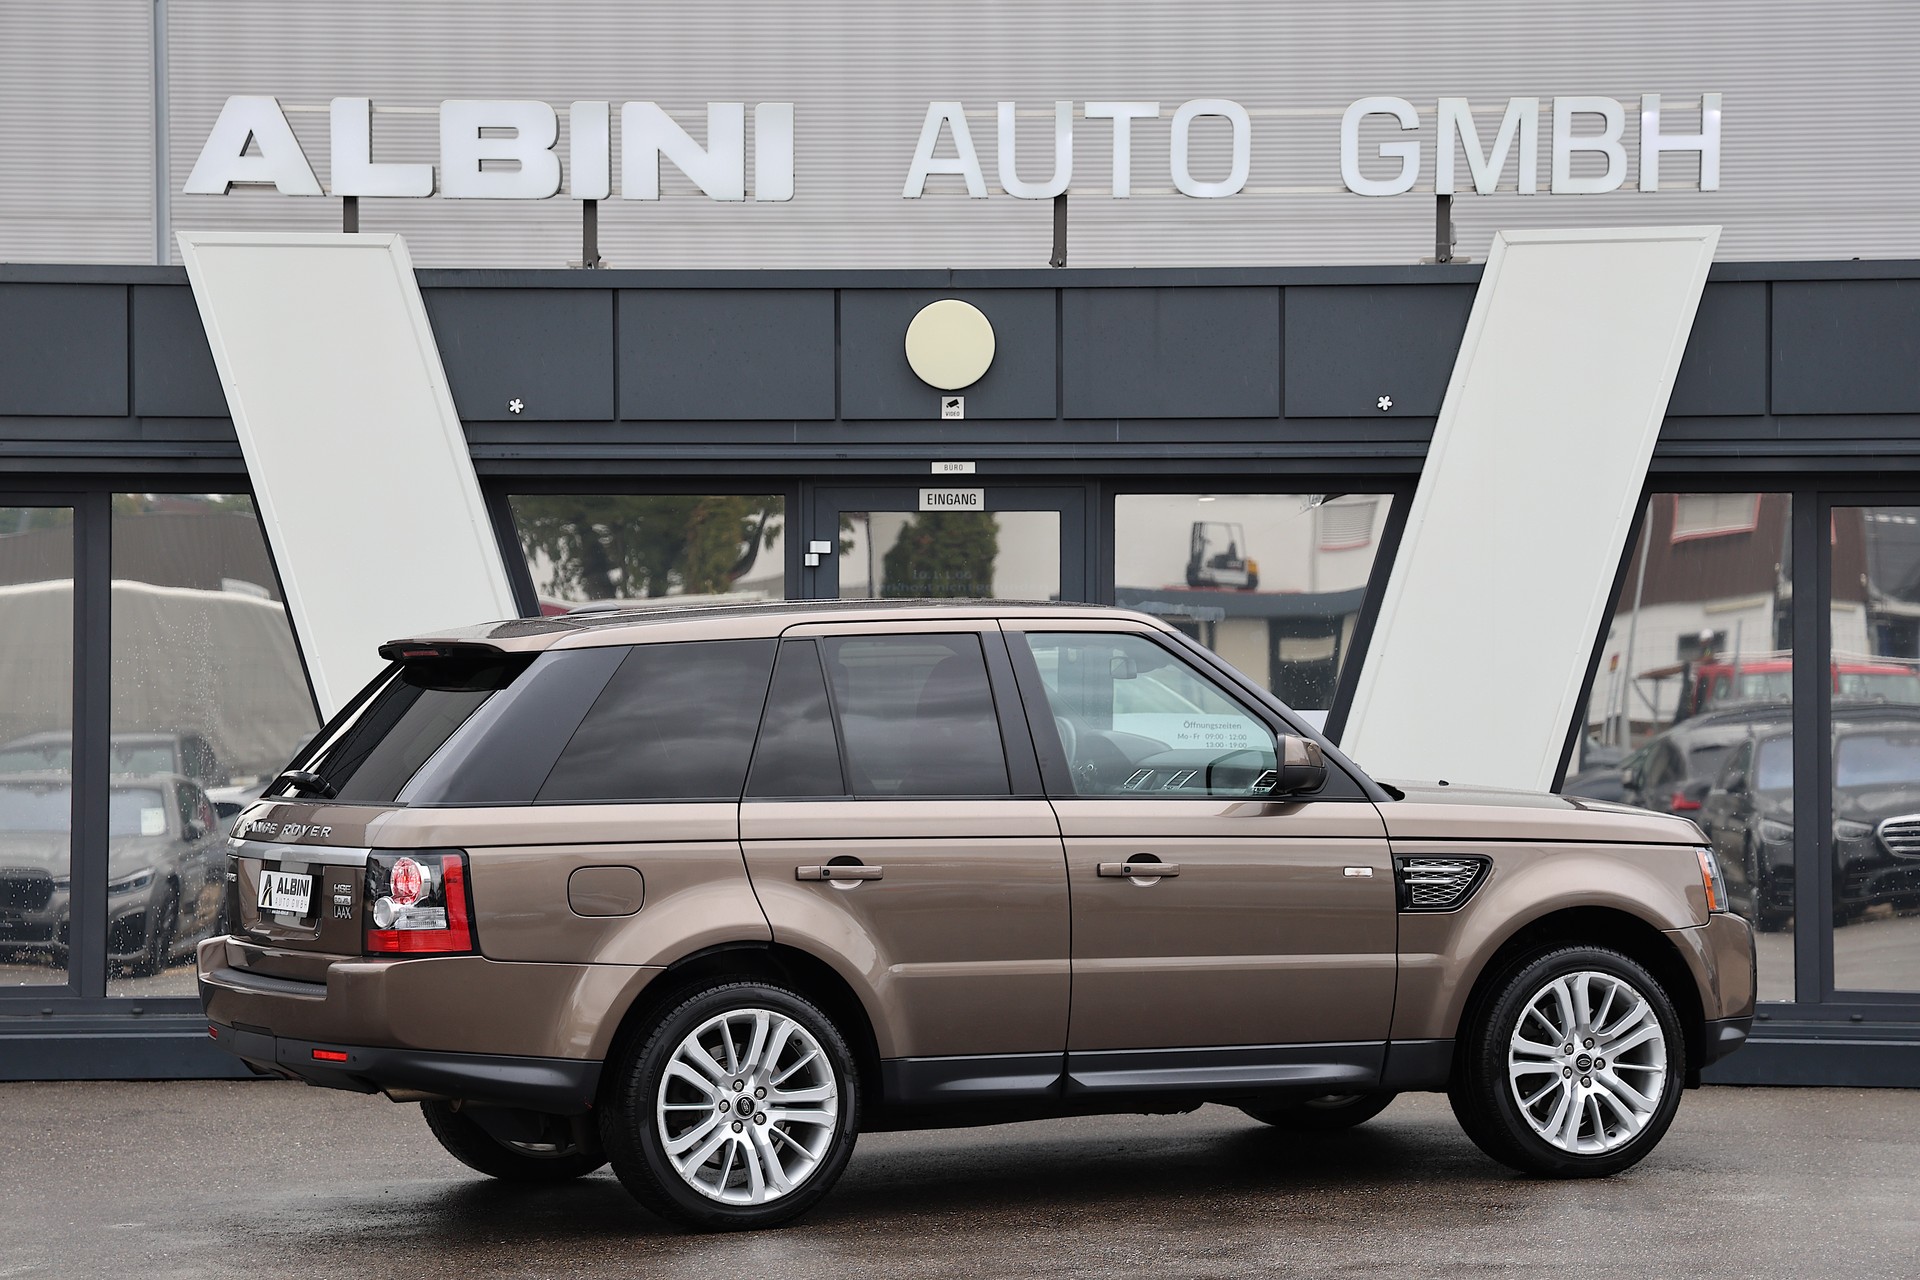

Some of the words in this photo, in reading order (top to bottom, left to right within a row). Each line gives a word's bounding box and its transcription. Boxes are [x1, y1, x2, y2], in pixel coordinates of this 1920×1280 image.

[183, 95, 795, 202] ALBINI
[901, 98, 1252, 199] AUTO
[1340, 92, 1723, 197] GMBH
[943, 463, 964, 471] BÜRO
[927, 493, 977, 506] EINGANG
[1183, 720, 1242, 730] Öffnungszeiten
[281, 823, 333, 838] ROVER
[276, 877, 310, 897] ALBINI
[333, 884, 352, 894] HSE
[333, 905, 352, 920] LAAX
